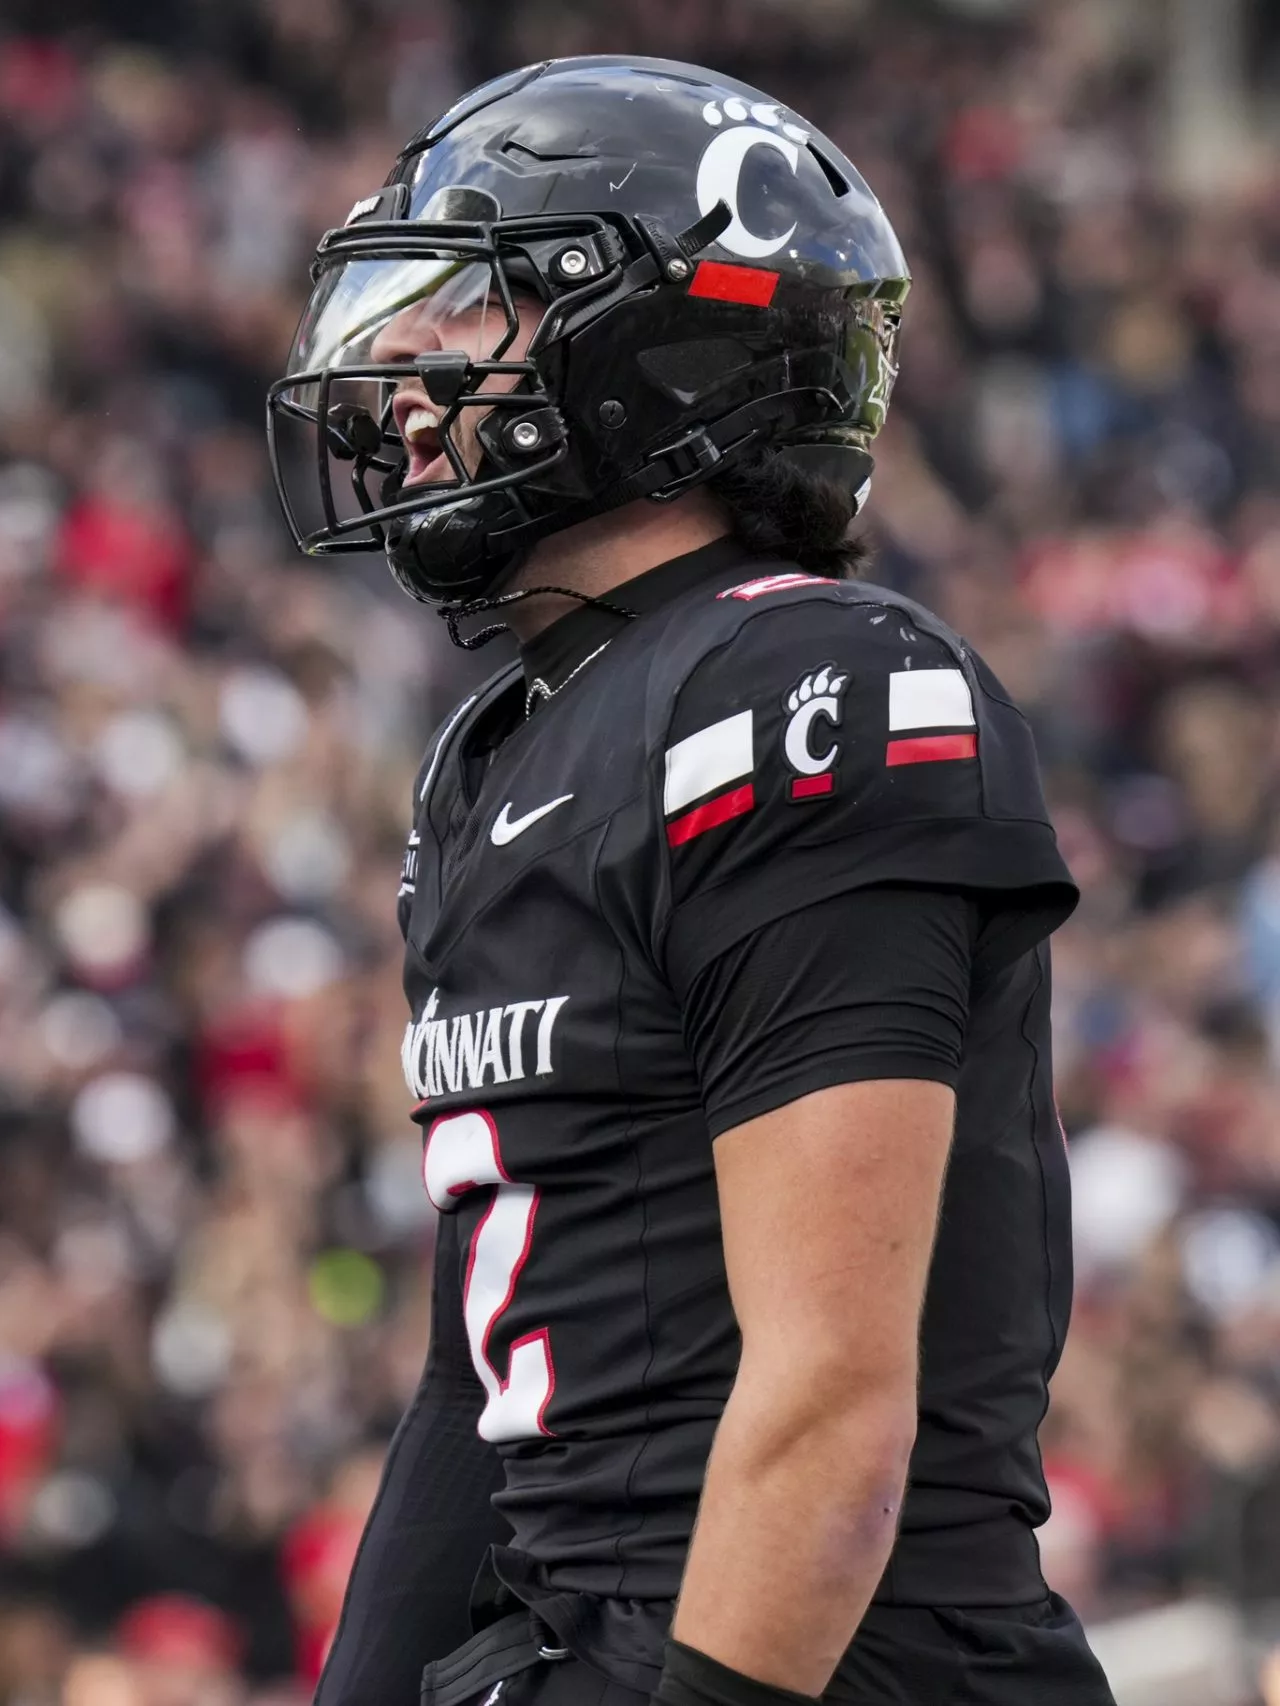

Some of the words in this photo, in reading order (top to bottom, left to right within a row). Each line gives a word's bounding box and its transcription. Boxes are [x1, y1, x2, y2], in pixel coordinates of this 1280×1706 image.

[696, 126, 799, 259] C
[784, 696, 839, 775] C
[422, 1107, 558, 1443] 2
